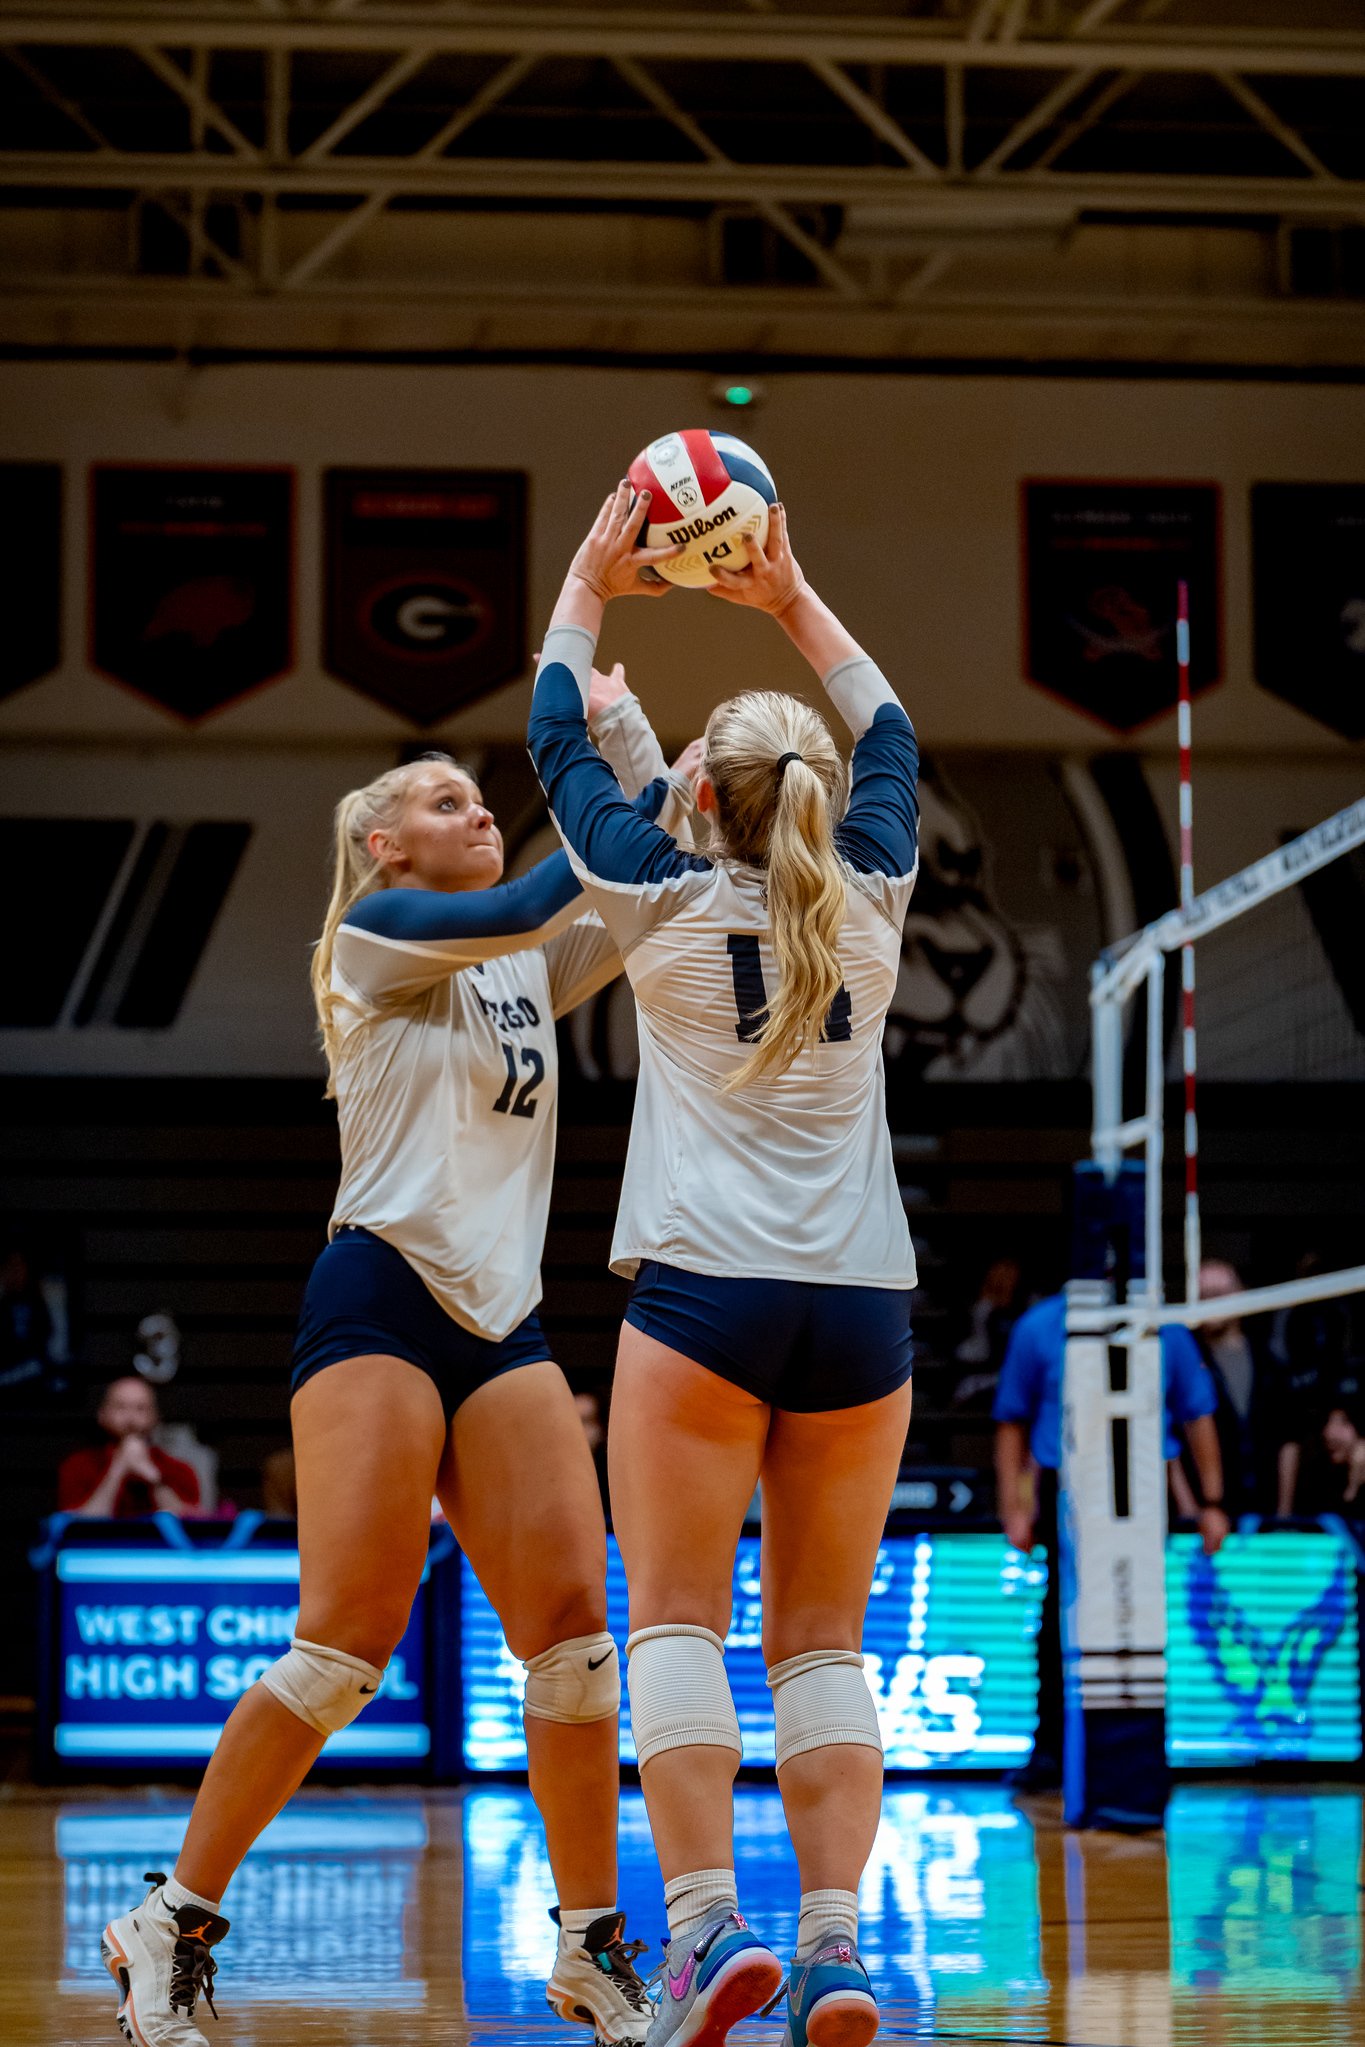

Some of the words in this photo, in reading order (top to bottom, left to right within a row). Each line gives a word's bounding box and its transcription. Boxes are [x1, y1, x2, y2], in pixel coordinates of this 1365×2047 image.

[666, 506, 738, 545] Wilson
[727, 934, 853, 1043] 1
[492, 1042, 545, 1118] 12
[75, 1605, 203, 1646] WEST
[65, 1654, 199, 1700] HIGH
